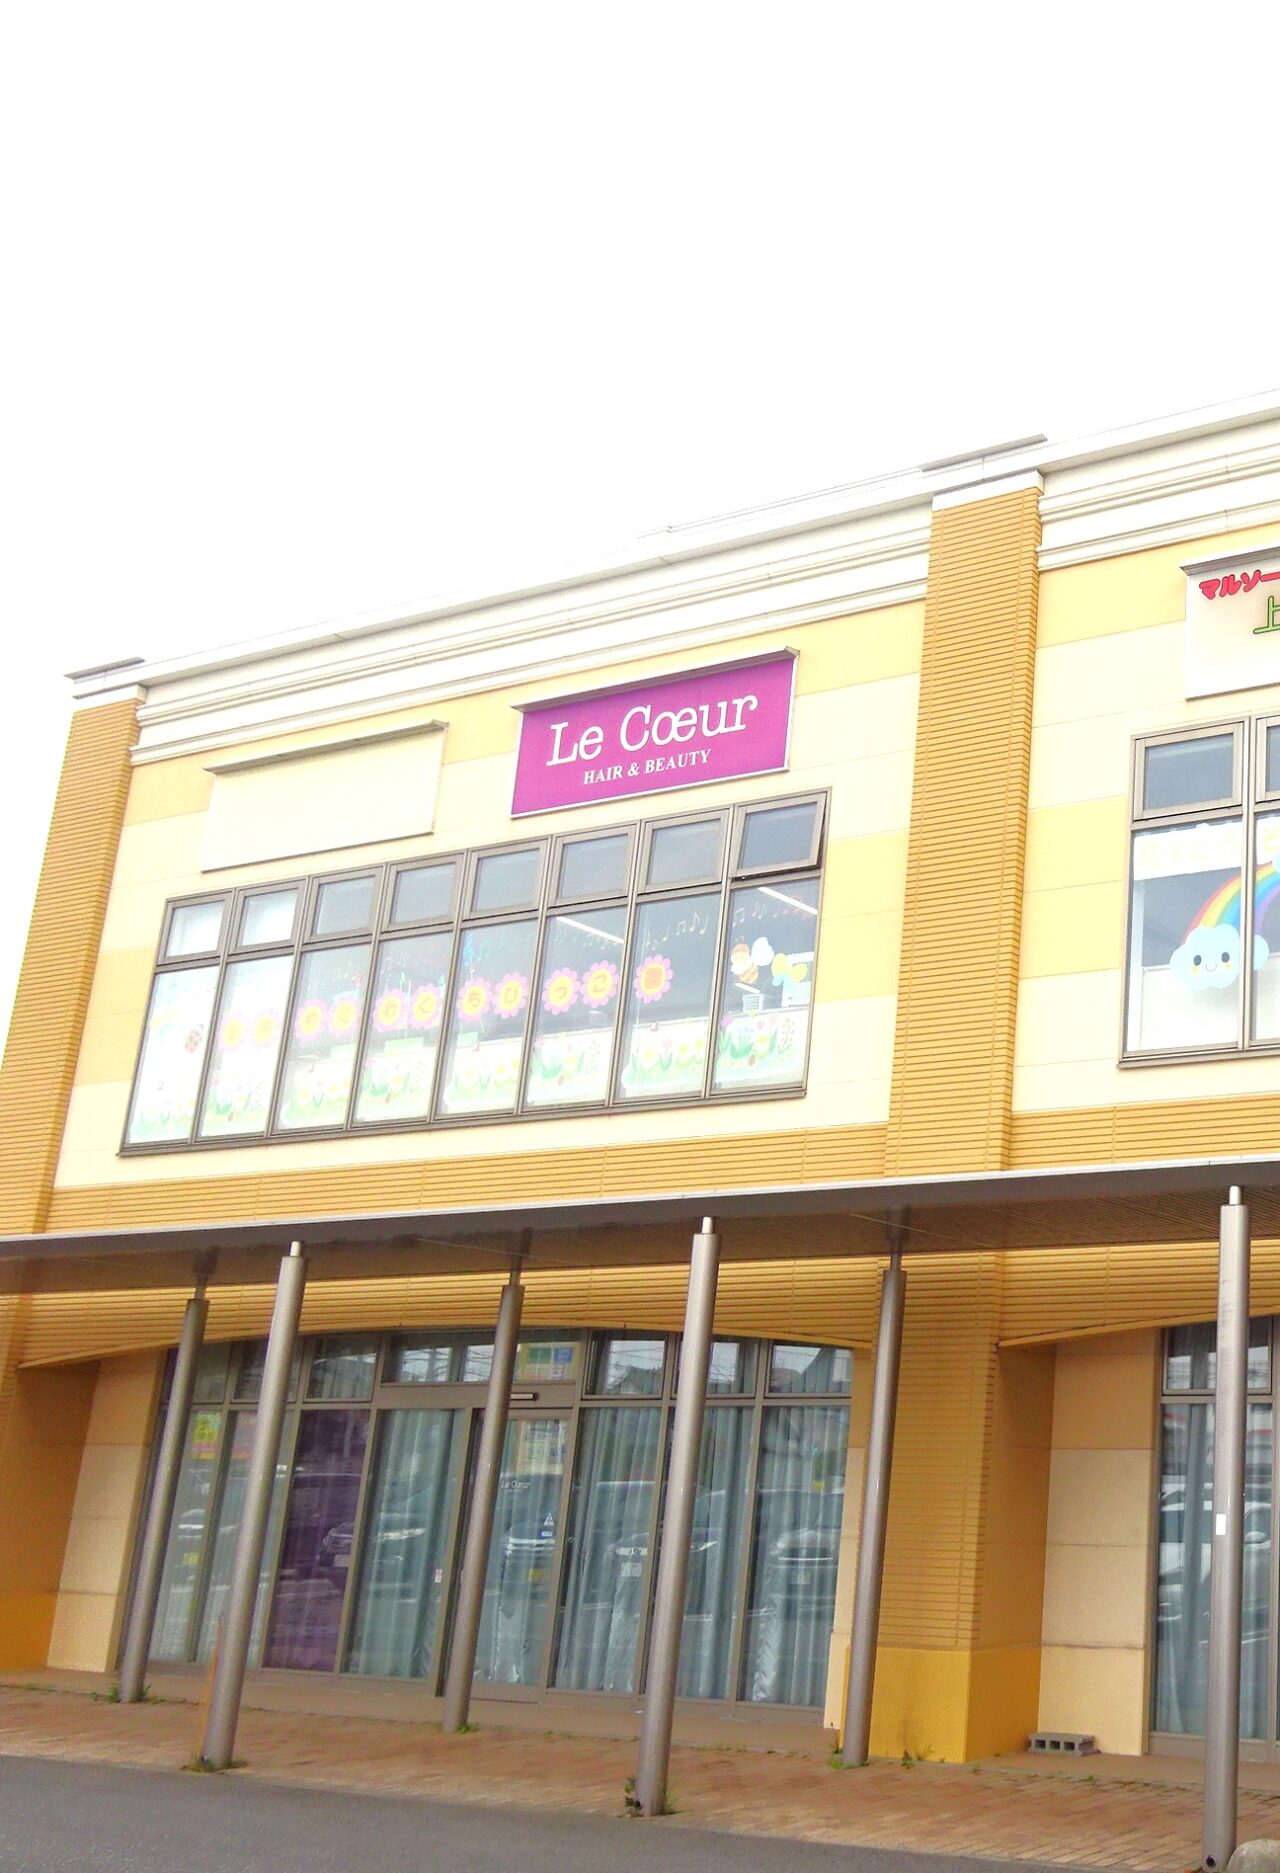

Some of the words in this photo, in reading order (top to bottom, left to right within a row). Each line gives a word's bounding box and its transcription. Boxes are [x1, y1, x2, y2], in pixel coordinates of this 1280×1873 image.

[546, 722, 604, 766] Le
[620, 694, 758, 751] Cœur
[583, 765, 623, 785] HAIR
[627, 762, 640, 777] &
[645, 748, 711, 773] BEAUTY
